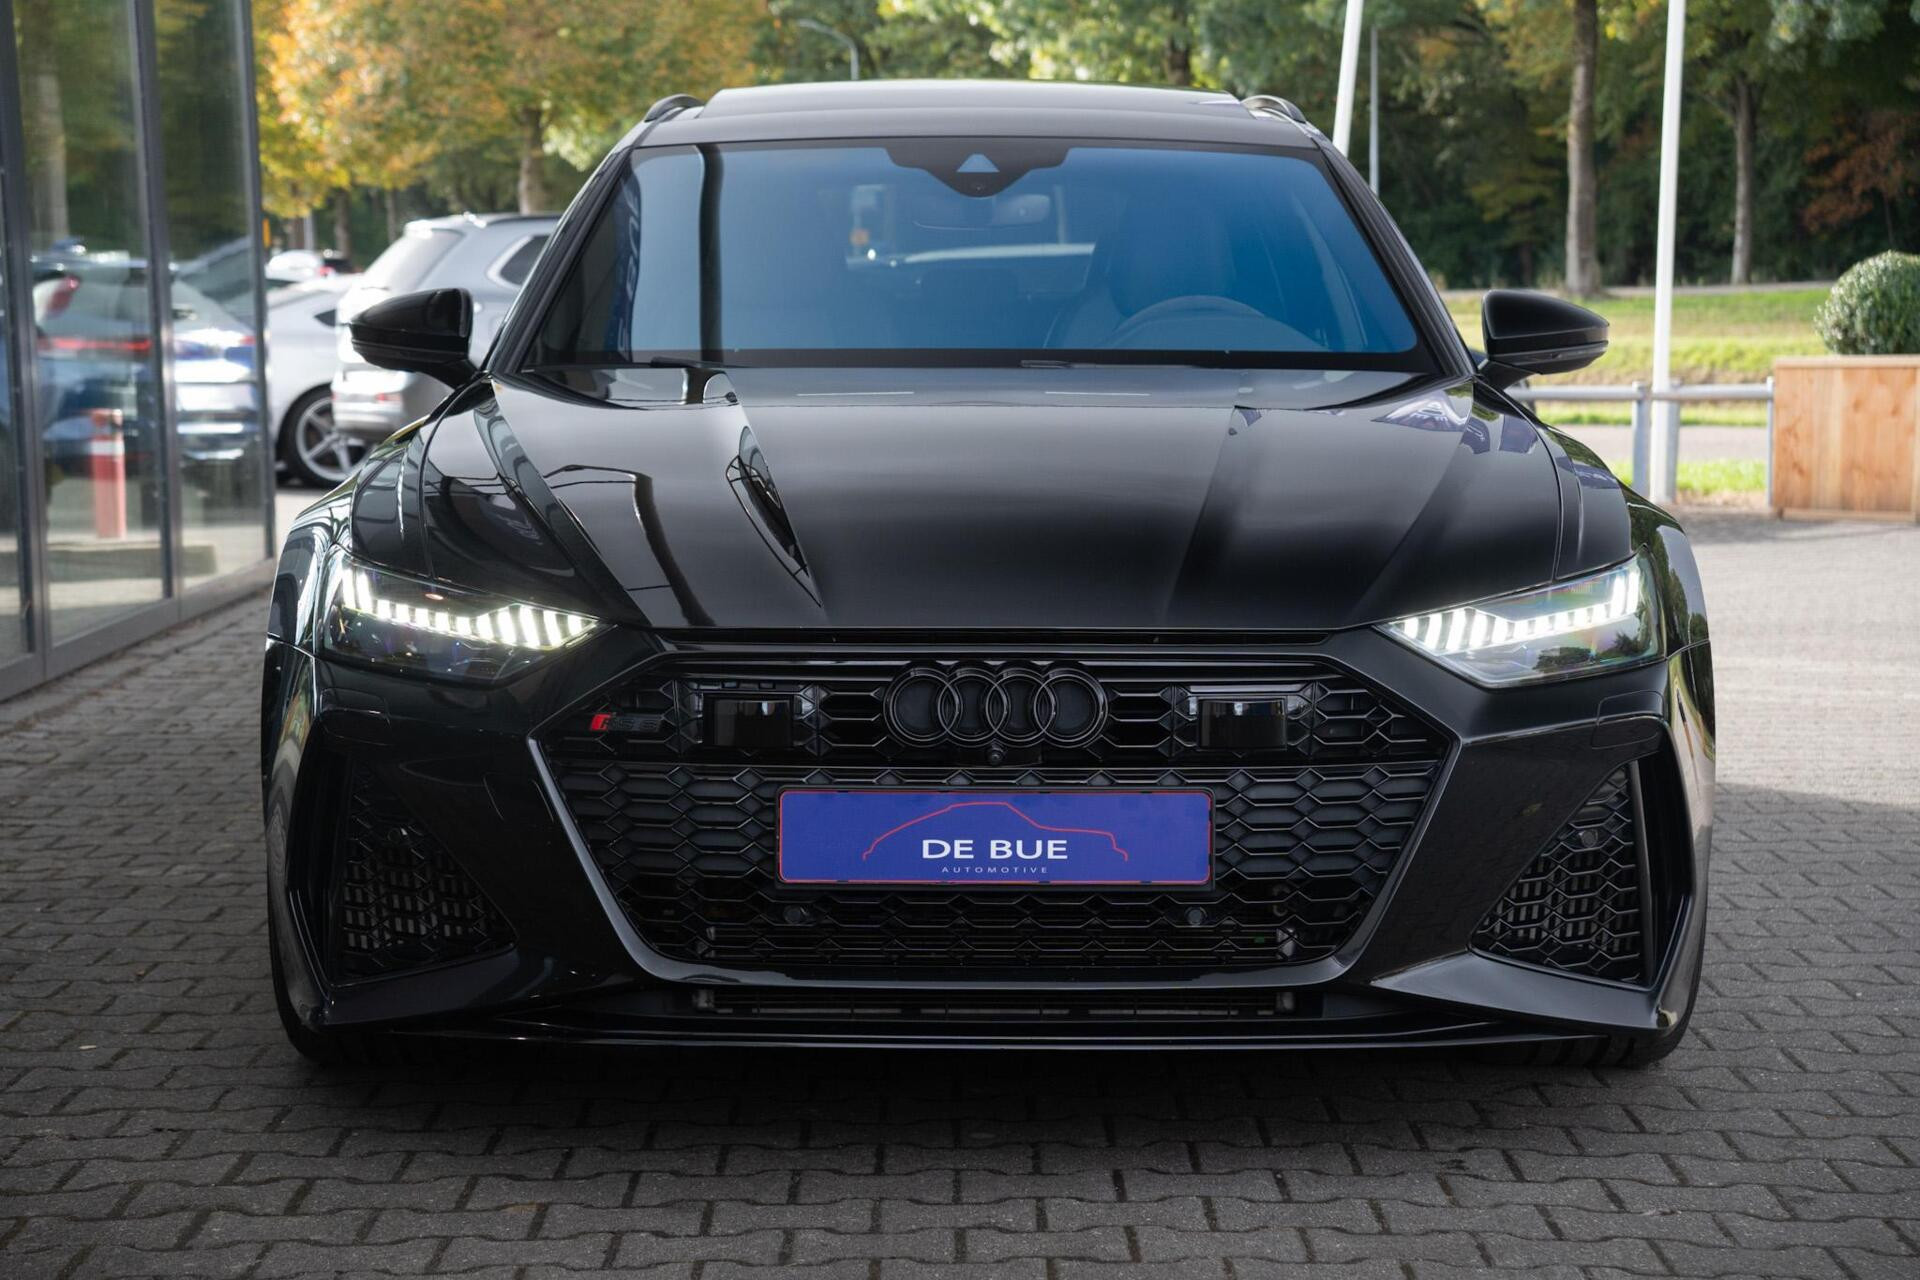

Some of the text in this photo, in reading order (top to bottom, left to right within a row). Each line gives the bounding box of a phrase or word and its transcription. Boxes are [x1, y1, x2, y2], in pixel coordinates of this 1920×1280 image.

[922, 839, 1068, 859] DE BUE
[941, 866, 1048, 874] AUTOMOTIVE
